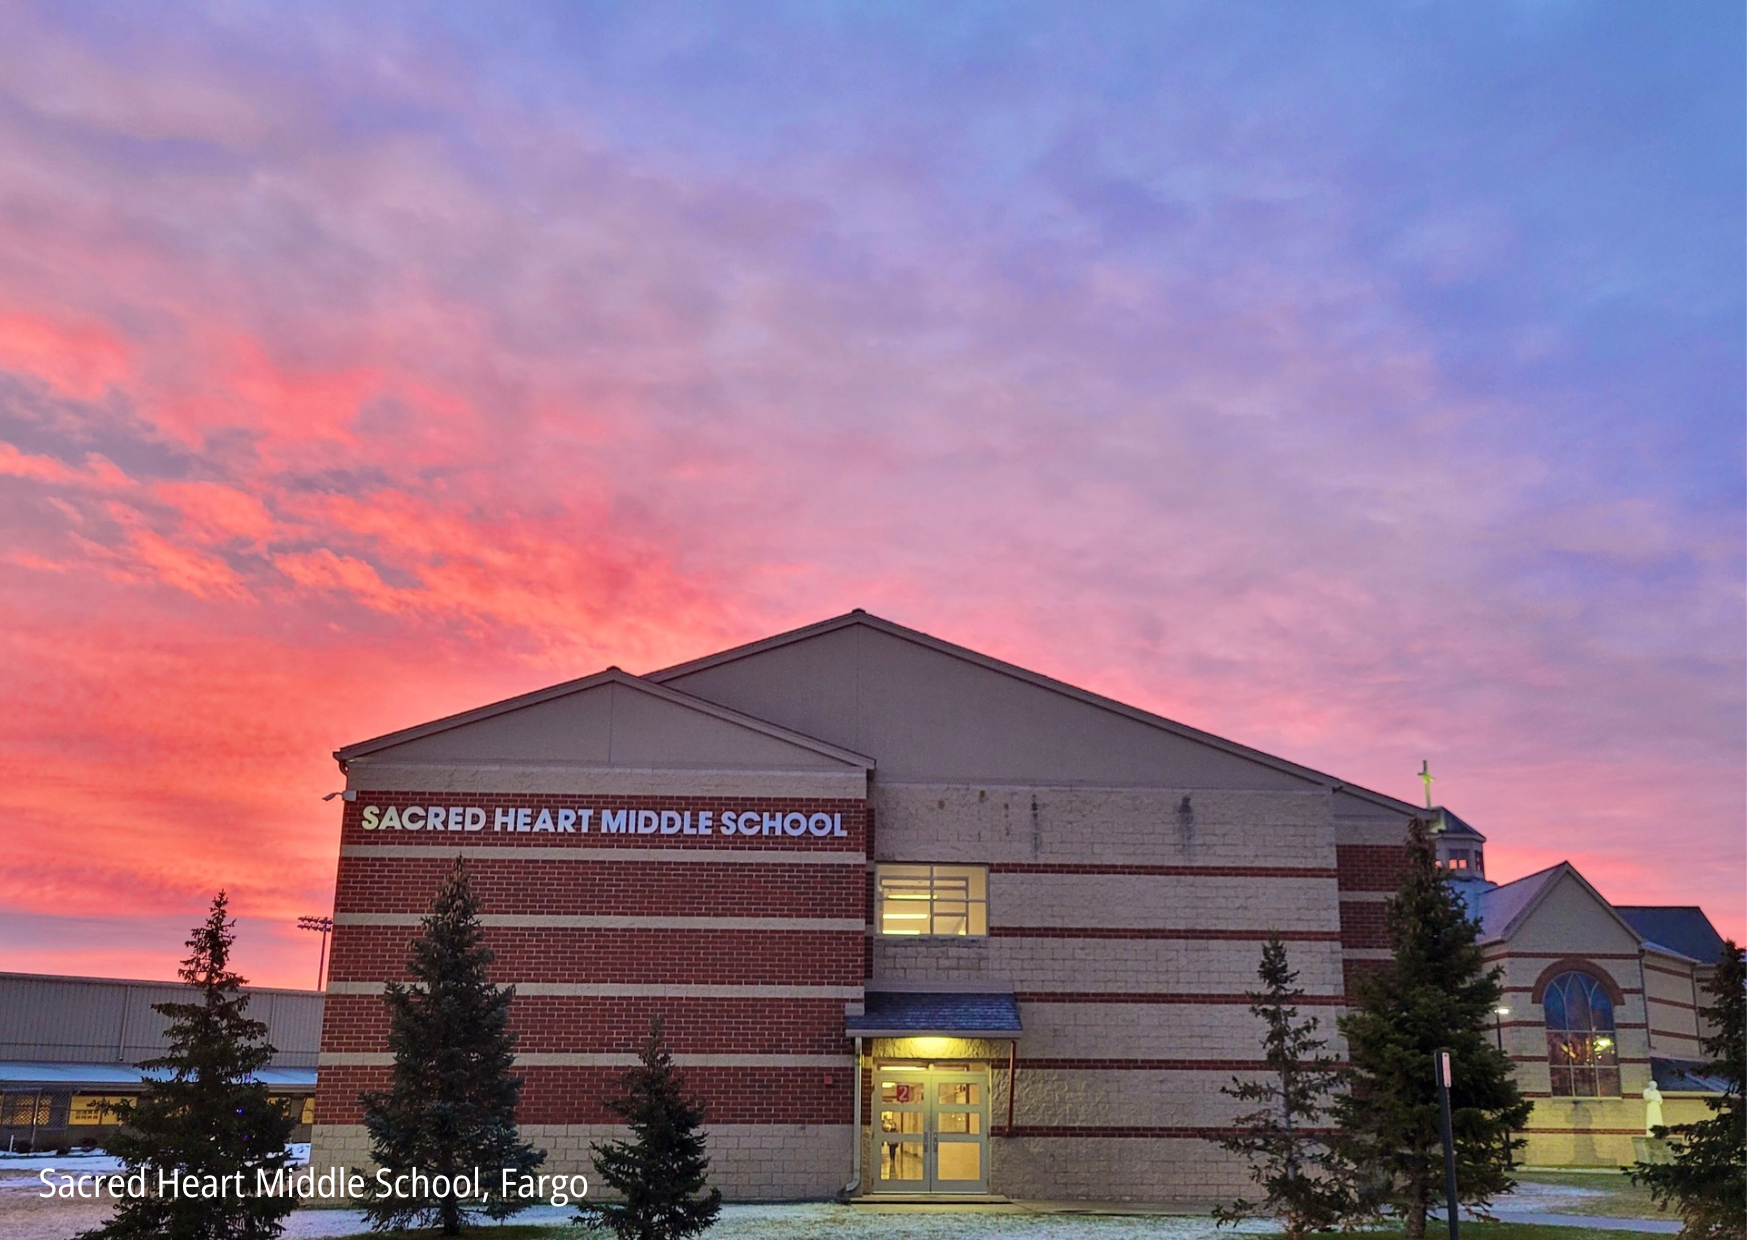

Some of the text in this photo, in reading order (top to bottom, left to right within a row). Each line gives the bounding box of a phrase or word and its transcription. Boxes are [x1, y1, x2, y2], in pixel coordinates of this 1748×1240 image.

[361, 805, 848, 837] SACRED HEART MIDDLE SCHOOL
[899, 1085, 908, 1100] 2
